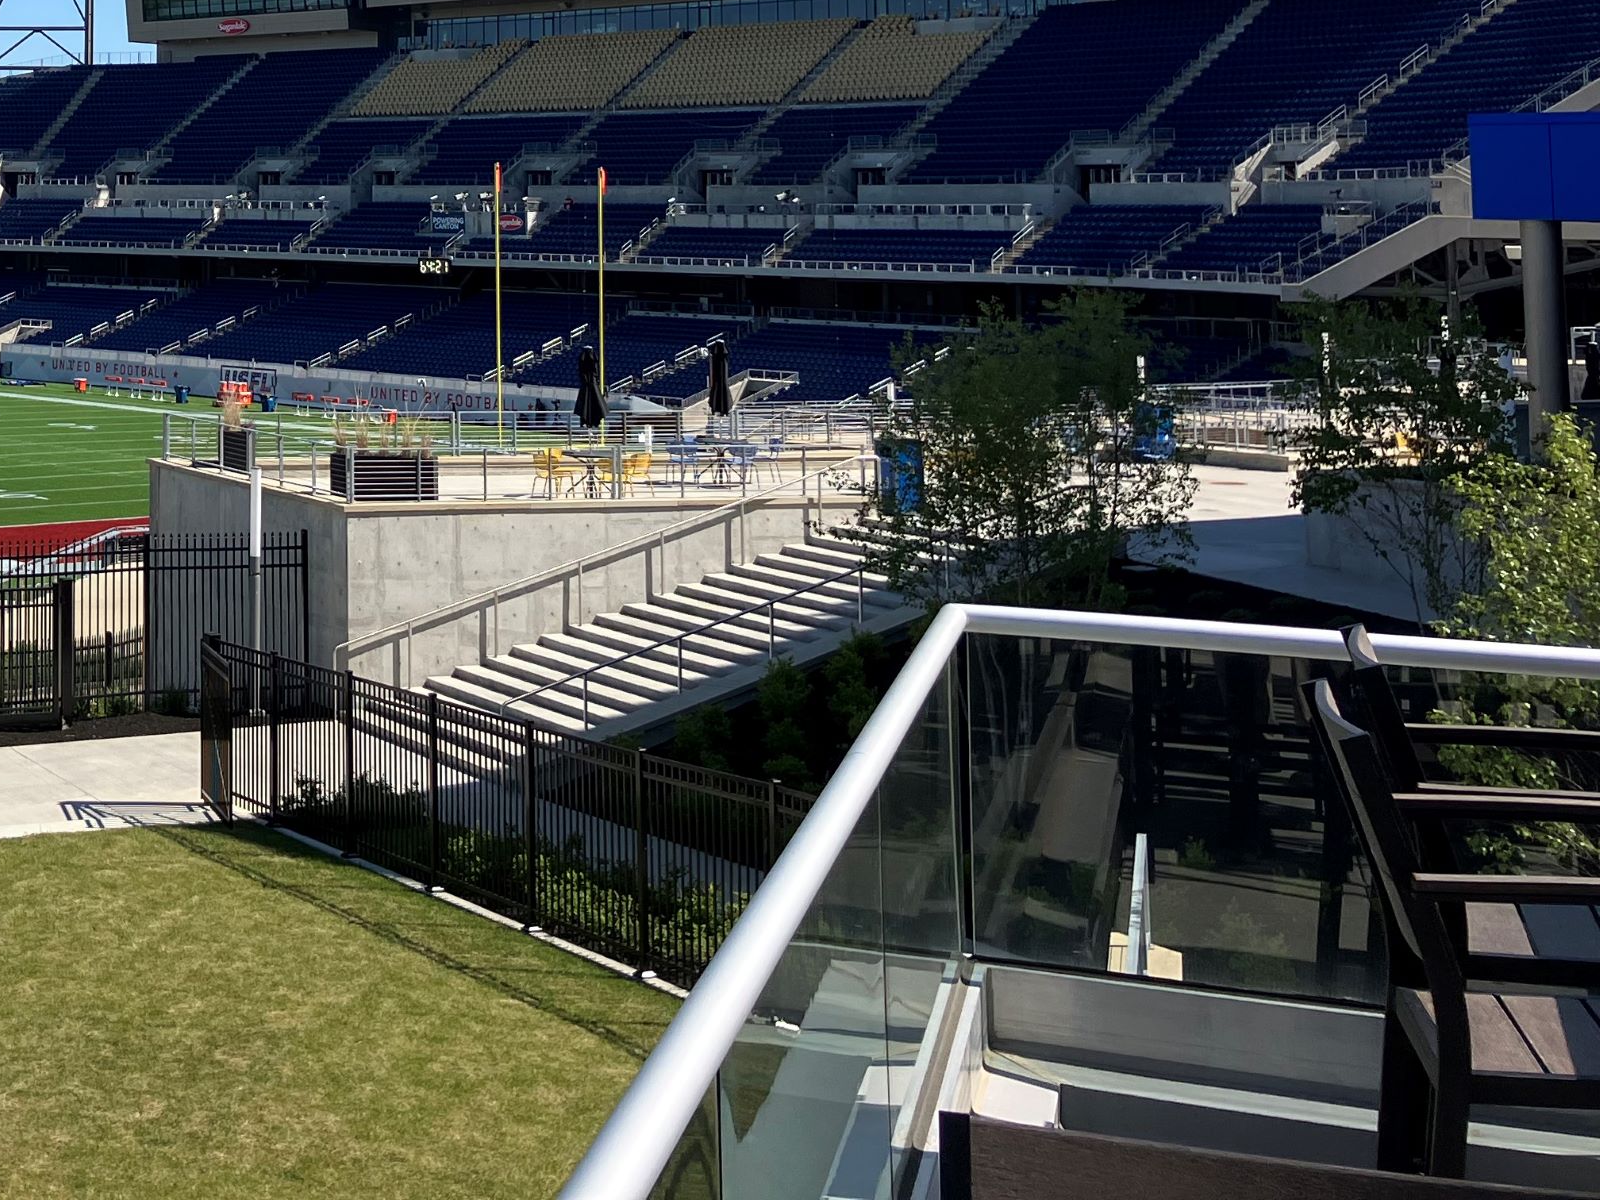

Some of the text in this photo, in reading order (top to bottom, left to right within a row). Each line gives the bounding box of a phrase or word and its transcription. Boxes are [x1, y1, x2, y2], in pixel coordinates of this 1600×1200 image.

[95, 364, 108, 373] BY
[113, 364, 166, 379] FOOTBALL
[370, 386, 418, 402] UNITED
